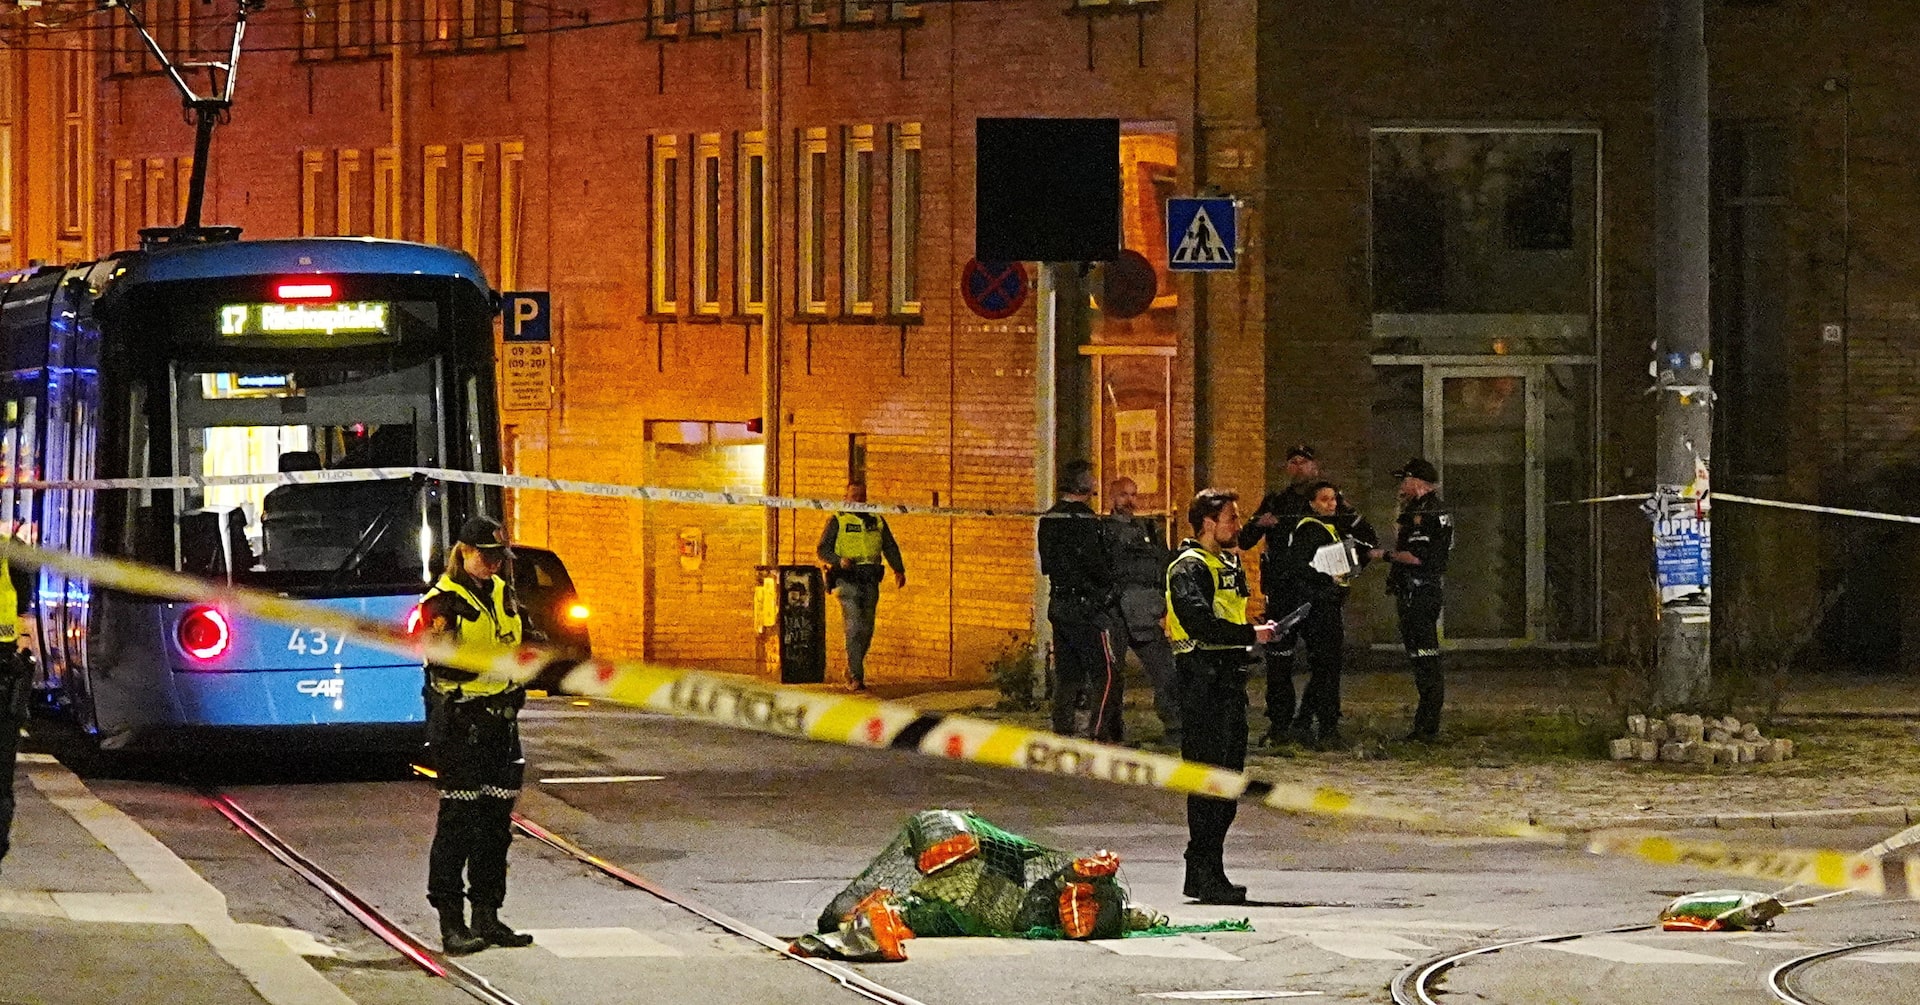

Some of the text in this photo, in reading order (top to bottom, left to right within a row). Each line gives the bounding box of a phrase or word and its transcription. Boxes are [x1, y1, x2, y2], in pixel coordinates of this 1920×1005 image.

[221, 305, 247, 334] 17
[514, 297, 539, 336] P
[287, 628, 346, 655] 437
[296, 679, 344, 698] CAF
